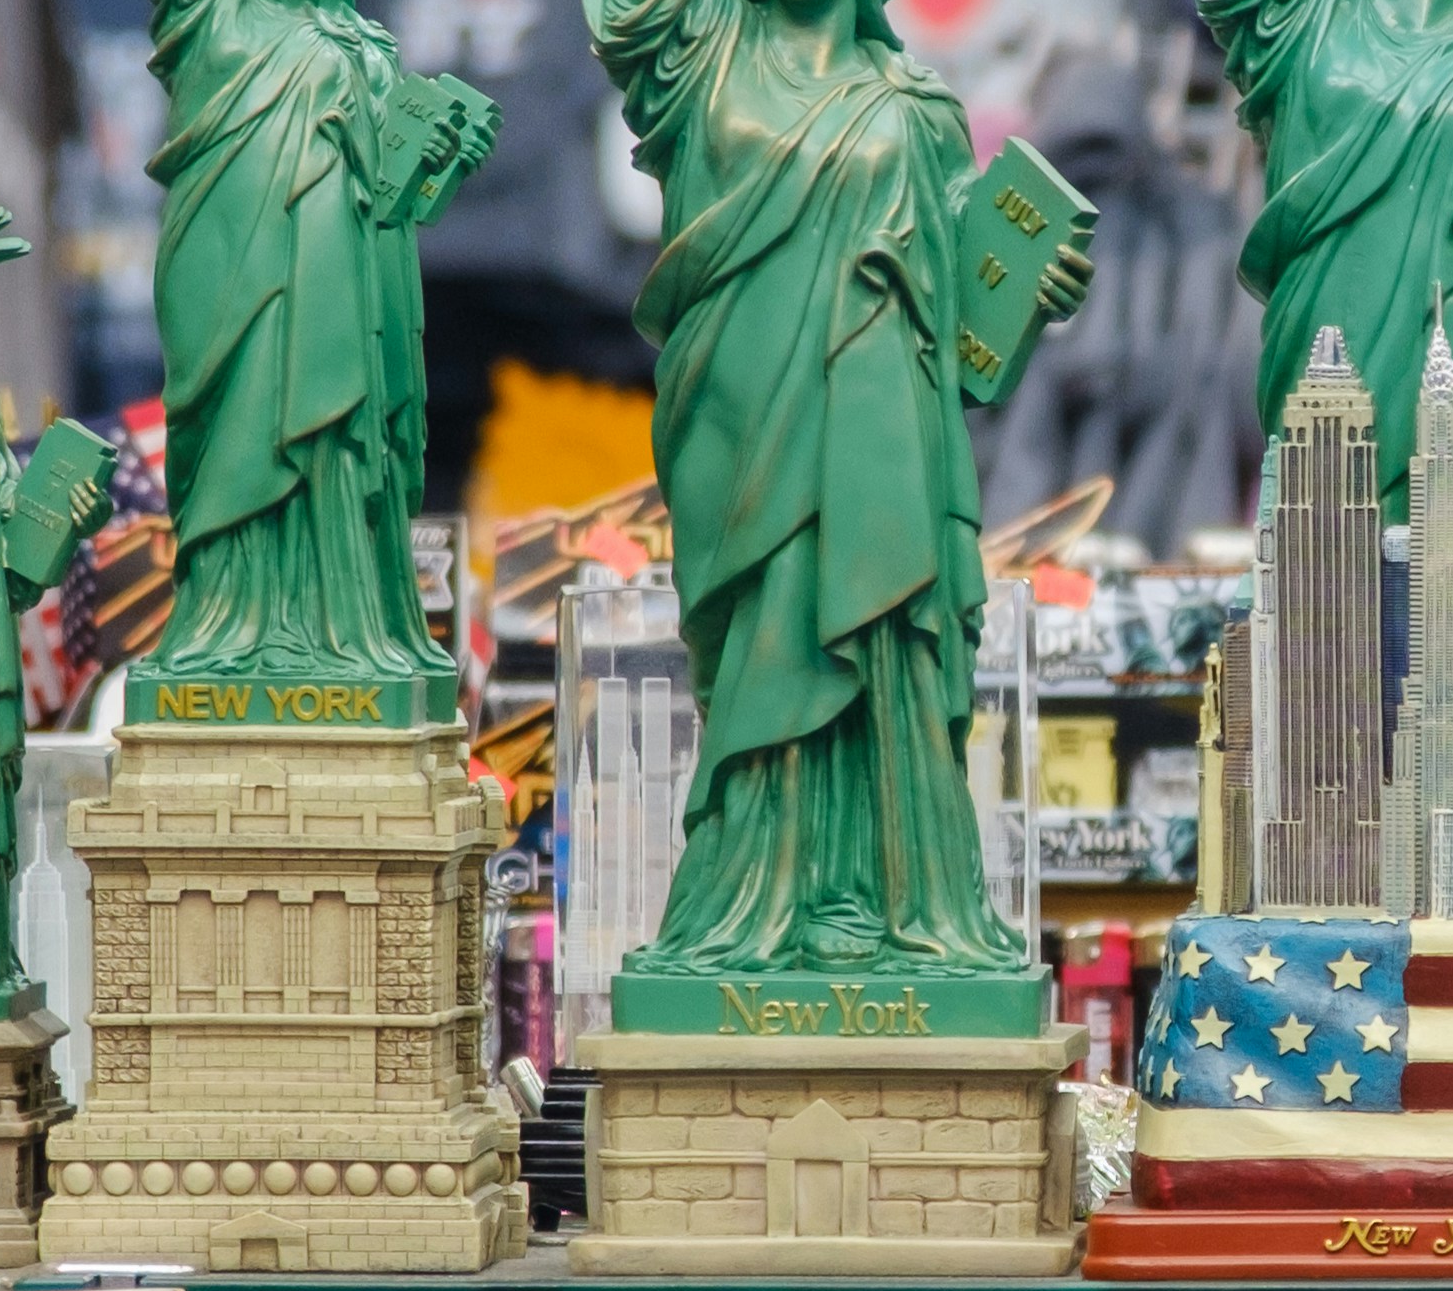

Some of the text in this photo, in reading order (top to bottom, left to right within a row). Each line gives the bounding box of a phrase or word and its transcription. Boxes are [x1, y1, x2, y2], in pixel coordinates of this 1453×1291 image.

[158, 684, 383, 721] NEW YORK
[718, 981, 933, 1037] New York
